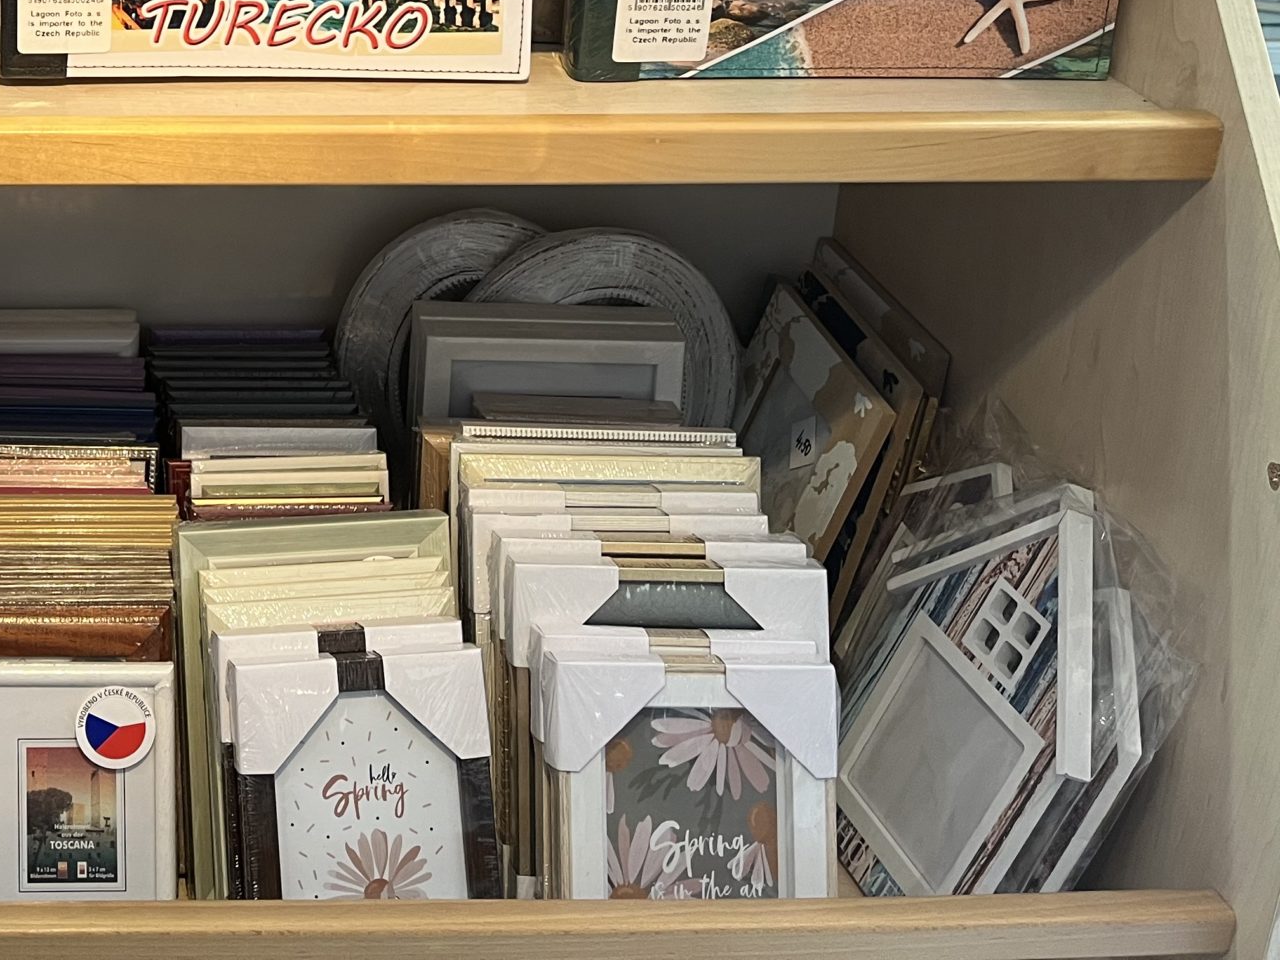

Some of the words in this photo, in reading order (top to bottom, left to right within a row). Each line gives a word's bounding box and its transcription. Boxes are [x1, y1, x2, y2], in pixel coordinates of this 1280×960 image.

[30, 10, 60, 18] Lagoon
[65, 29, 100, 37] Republic
[661, 36, 697, 44] Republic
[77, 695, 98, 729] VYROBENO
[103, 688, 124, 697] ČESKÉ
[124, 690, 152, 718] REPUBLICE
[322, 774, 409, 820] Spring
[50, 840, 95, 850] TOSCANA
[649, 820, 751, 881] Spring
[650, 881, 664, 899] is
[673, 883, 693, 899] in
[699, 870, 732, 899] the
[740, 883, 763, 898] air
